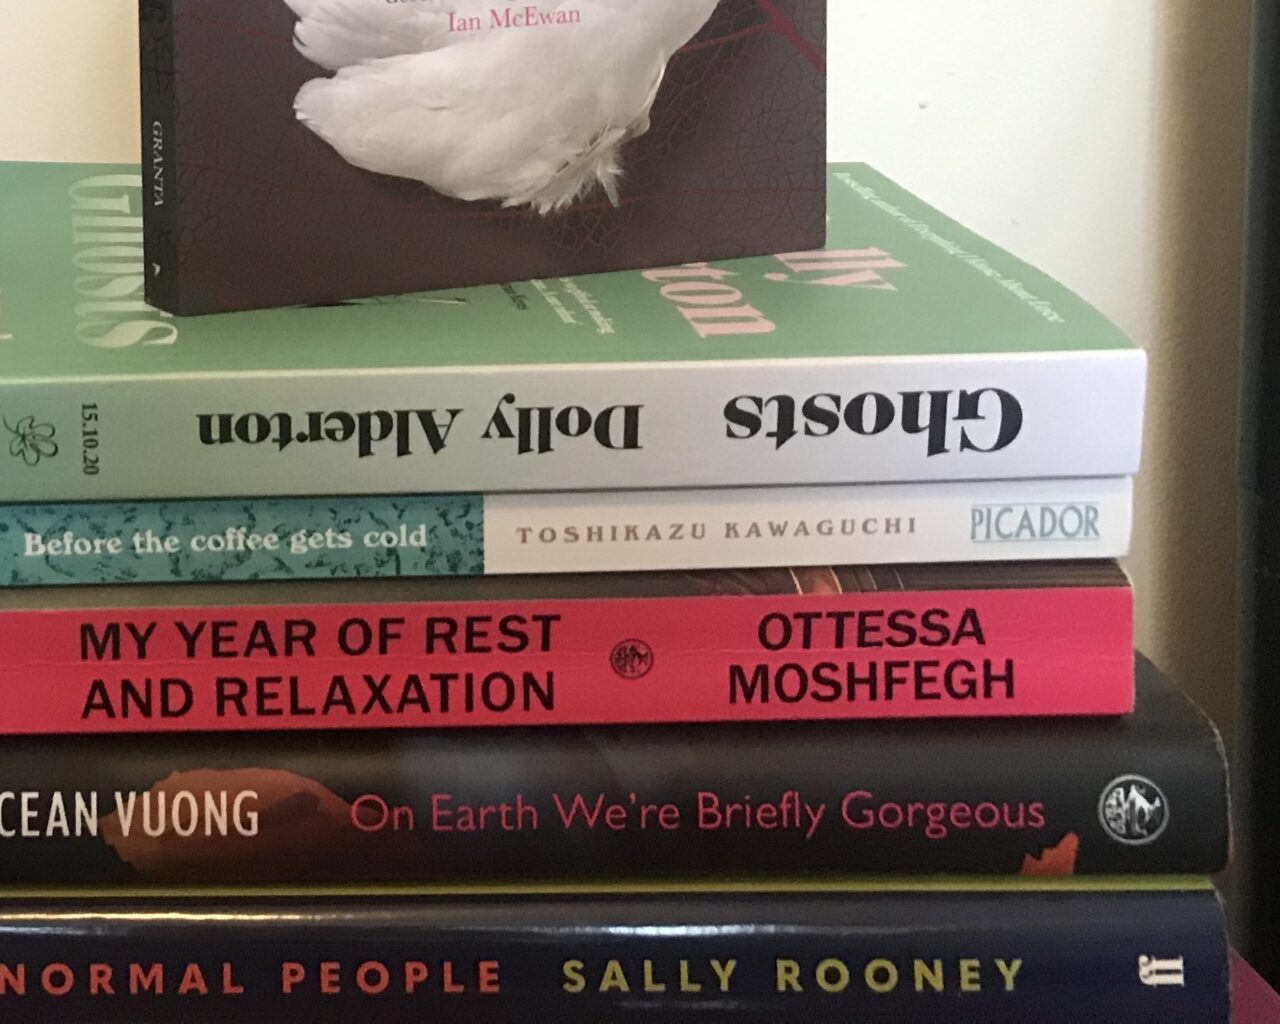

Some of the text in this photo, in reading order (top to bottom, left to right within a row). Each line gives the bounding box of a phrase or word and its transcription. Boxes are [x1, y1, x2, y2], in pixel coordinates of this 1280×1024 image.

[447, 5, 581, 33] Ian McEwan
[152, 120, 164, 206] GRANTA
[81, 402, 100, 476] 15.10.20
[196, 393, 644, 459] Dolly Alderton
[723, 387, 1023, 457] Ghosts
[23, 524, 428, 558] Before the coffee gets cold
[516, 516, 917, 545] TOSHIKAZU KAWAGUCHI
[970, 503, 1100, 542] PICADOR
[79, 613, 561, 661] MY YEAR OF REST
[758, 608, 986, 651] OTTESSA
[81, 671, 555, 720] AND RELAXATION
[728, 658, 1015, 705] MOSHFEGH
[116, 790, 260, 837] VUONG
[350, 794, 414, 832] On
[431, 793, 538, 832] Earth
[698, 790, 827, 840] Briefly
[841, 789, 1045, 839] Gorgeous
[282, 959, 501, 994] PEOPLE
[563, 957, 1023, 994] SALLY ROONEY
